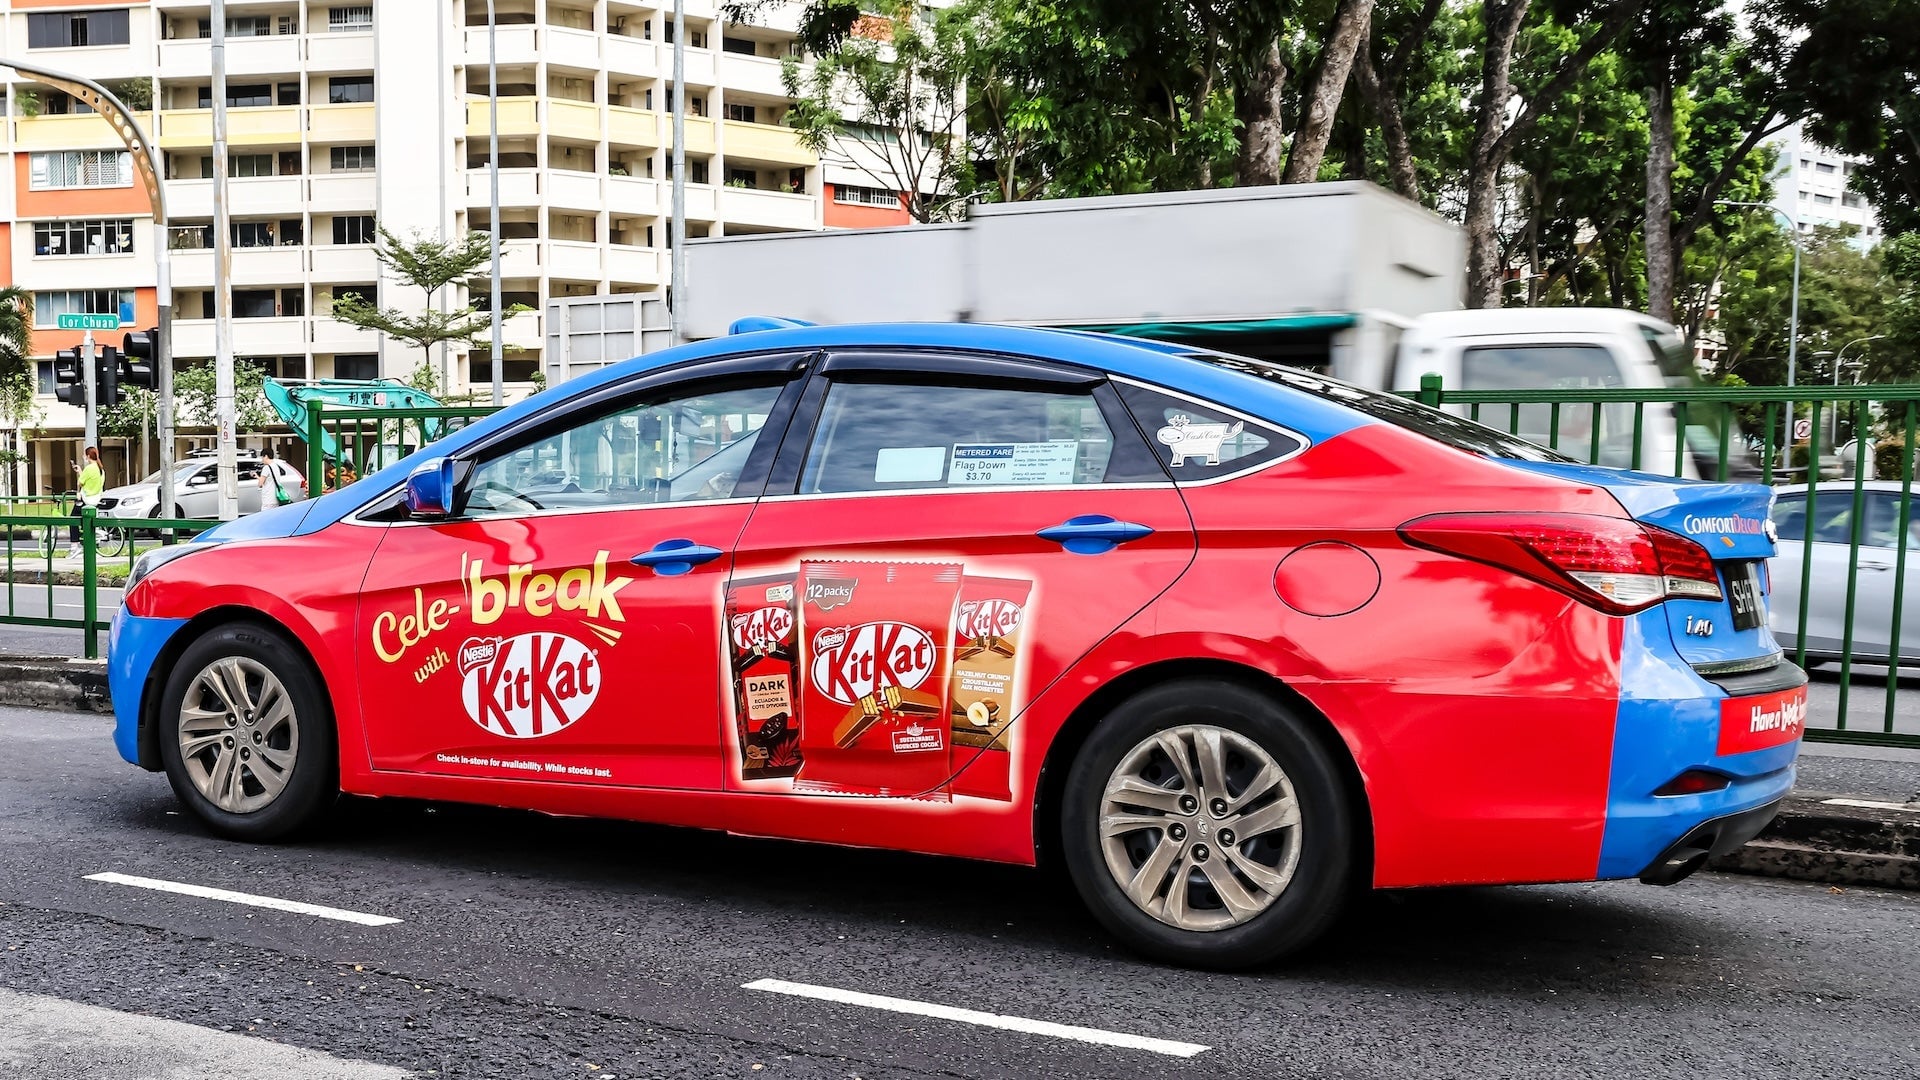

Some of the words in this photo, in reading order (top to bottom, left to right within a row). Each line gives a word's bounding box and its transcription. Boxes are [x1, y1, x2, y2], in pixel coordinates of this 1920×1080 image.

[62, 315, 78, 328] Lor
[82, 315, 114, 328] Chuan
[955, 461, 976, 471] Flag
[978, 461, 1006, 469] Down
[966, 472, 992, 480] $3.70
[808, 584, 823, 598] 12
[824, 585, 850, 597] packs
[371, 587, 462, 664] Cele-
[469, 549, 635, 626] break
[965, 600, 1018, 638] KitKat
[740, 608, 790, 648] KitKat
[413, 646, 451, 684] with
[828, 623, 928, 702] KitKat
[957, 670, 987, 678] HAZELNUT
[987, 673, 1011, 681] CRUNCH
[477, 635, 595, 736] KitKat
[749, 680, 786, 692] DARK
[962, 678, 1004, 687] CROUSTILLANT
[974, 685, 1004, 693] NOISETTES
[1750, 705, 1775, 732] Have
[1774, 710, 1781, 728] a
[899, 735, 935, 743] SUSTAINABLY
[895, 742, 919, 750] SOURCED
[436, 753, 460, 763] Check
[460, 755, 489, 767] in-store
[489, 757, 501, 766] for
[501, 759, 544, 773] availability.
[544, 763, 567, 773] While
[567, 766, 594, 775] stocks
[594, 768, 613, 777] last.
